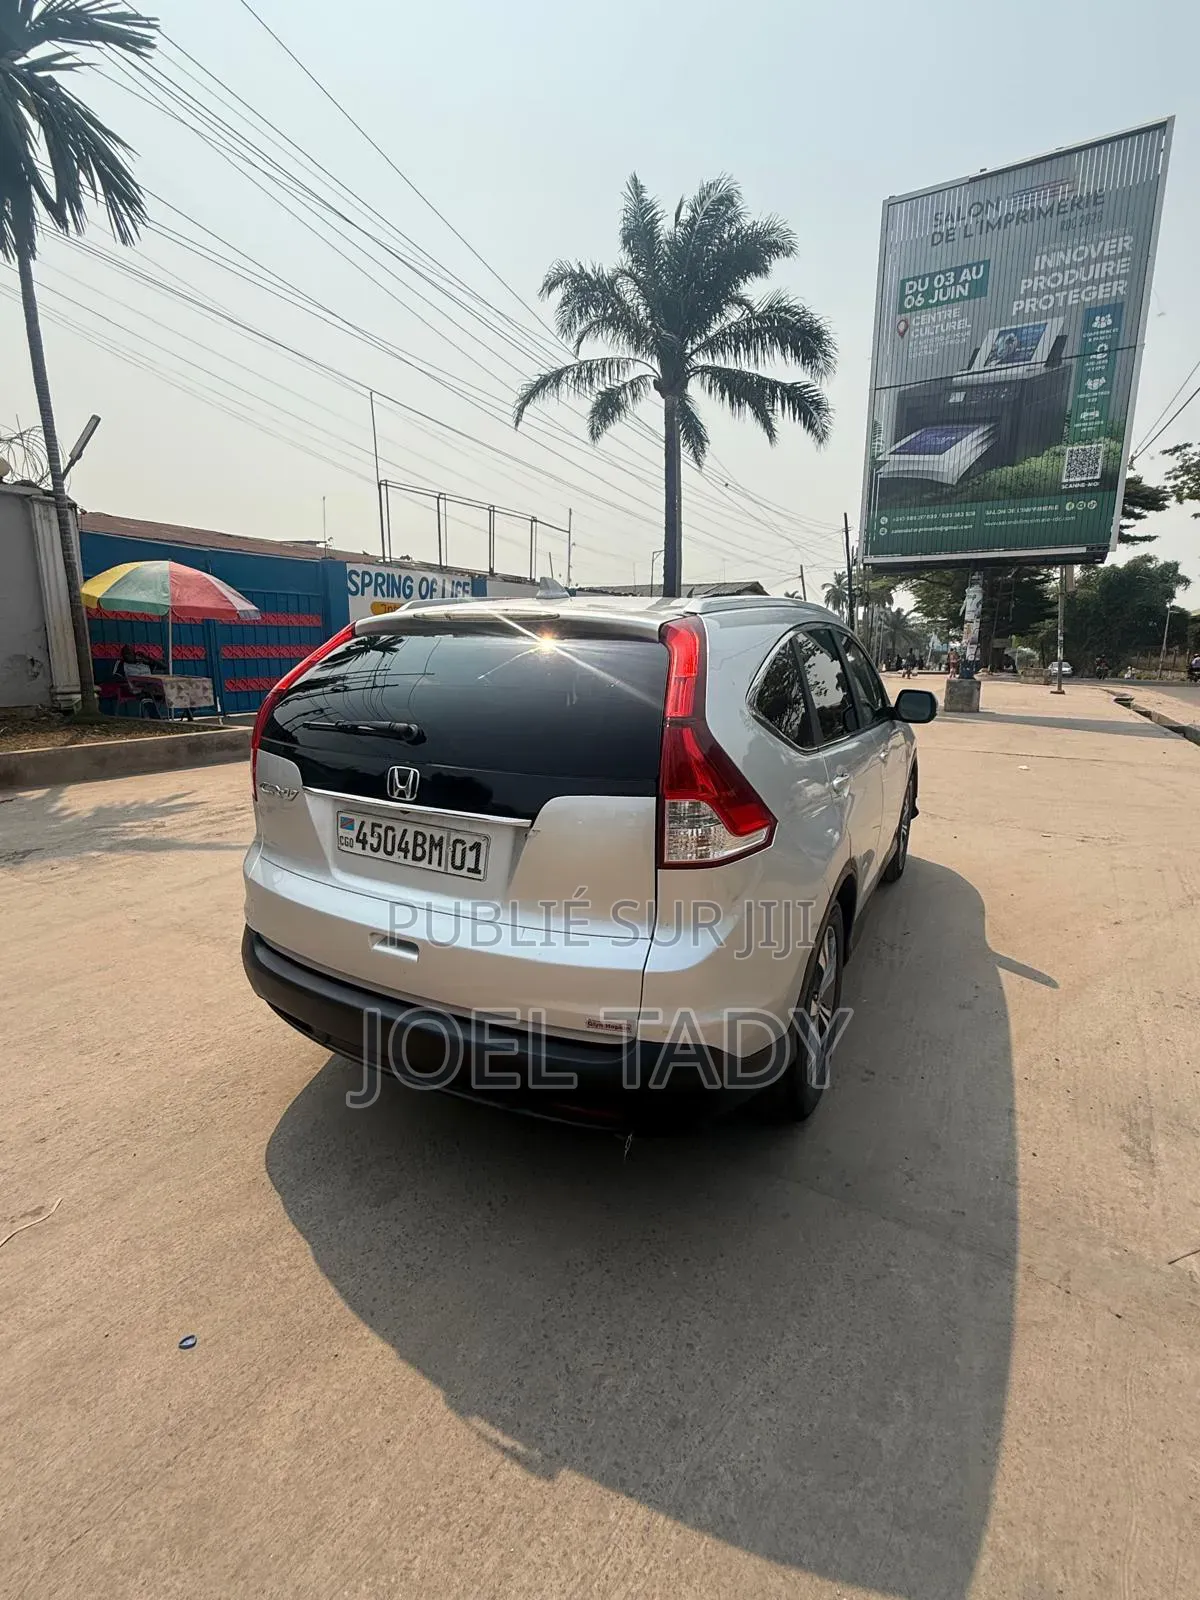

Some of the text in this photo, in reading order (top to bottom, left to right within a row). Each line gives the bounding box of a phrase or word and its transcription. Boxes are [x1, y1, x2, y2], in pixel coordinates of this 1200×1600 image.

[931, 227, 956, 247] DE
[964, 189, 1105, 239] L'IMPRIMERIE
[934, 196, 1000, 228] SALON
[1034, 236, 1134, 272] INNOVER
[905, 264, 984, 295] DU 03 AU
[1020, 257, 1131, 294] PRODUIRE
[904, 282, 970, 309] 06 JUIN
[1012, 280, 1129, 316] PROTEGER
[911, 317, 972, 338] CULTUREL
[912, 308, 961, 326] CENTRE
[347, 569, 414, 600] SPRING
[418, 576, 438, 600] OF
[450, 838, 483, 875] 01
